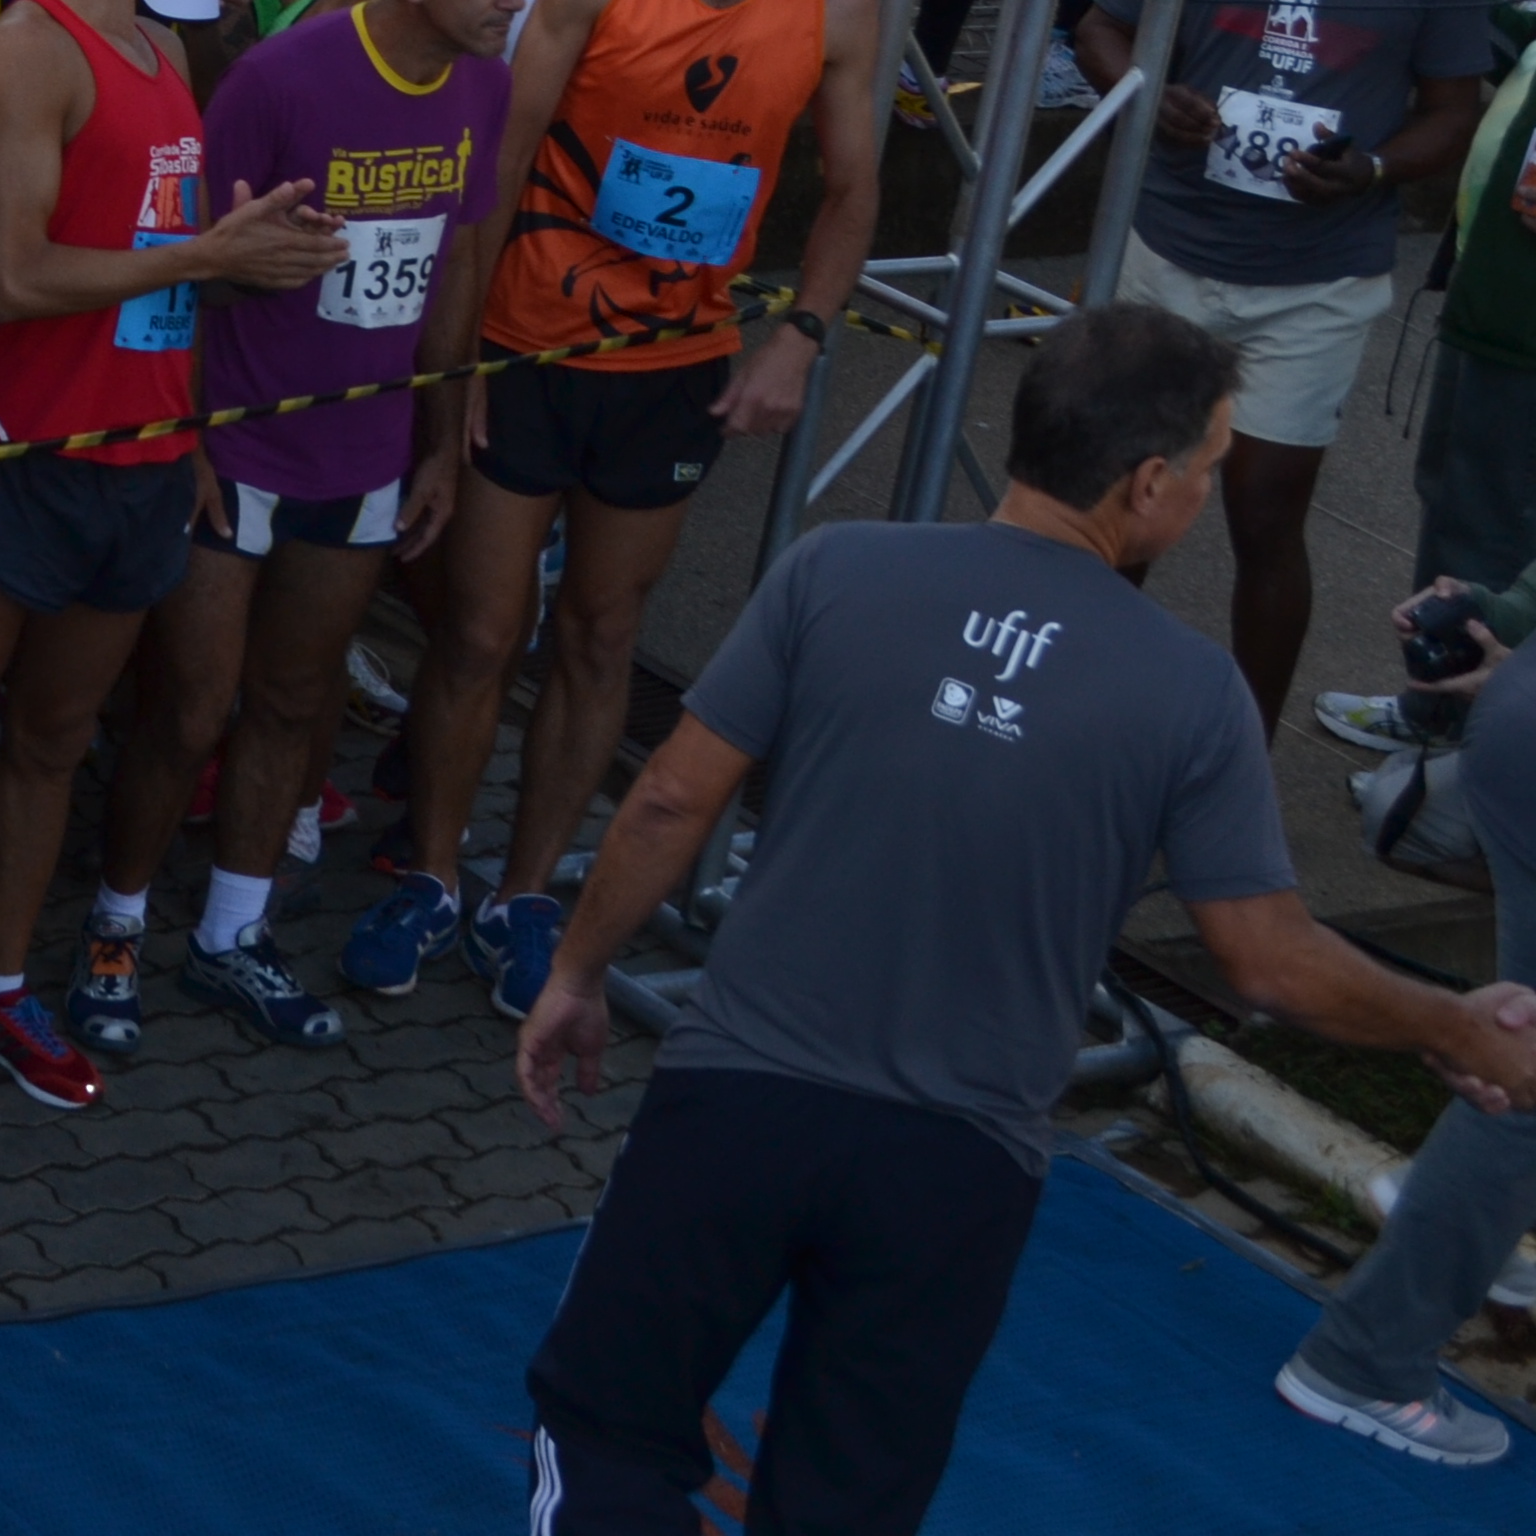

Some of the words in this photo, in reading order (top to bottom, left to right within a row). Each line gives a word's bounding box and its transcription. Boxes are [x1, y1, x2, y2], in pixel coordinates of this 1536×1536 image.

[1271, 53, 1314, 74] UFJF
[654, 185, 696, 228] 2
[610, 210, 704, 247] EDEVALDO
[963, 609, 1063, 682] ufjf
[976, 709, 1021, 737] VIVA
